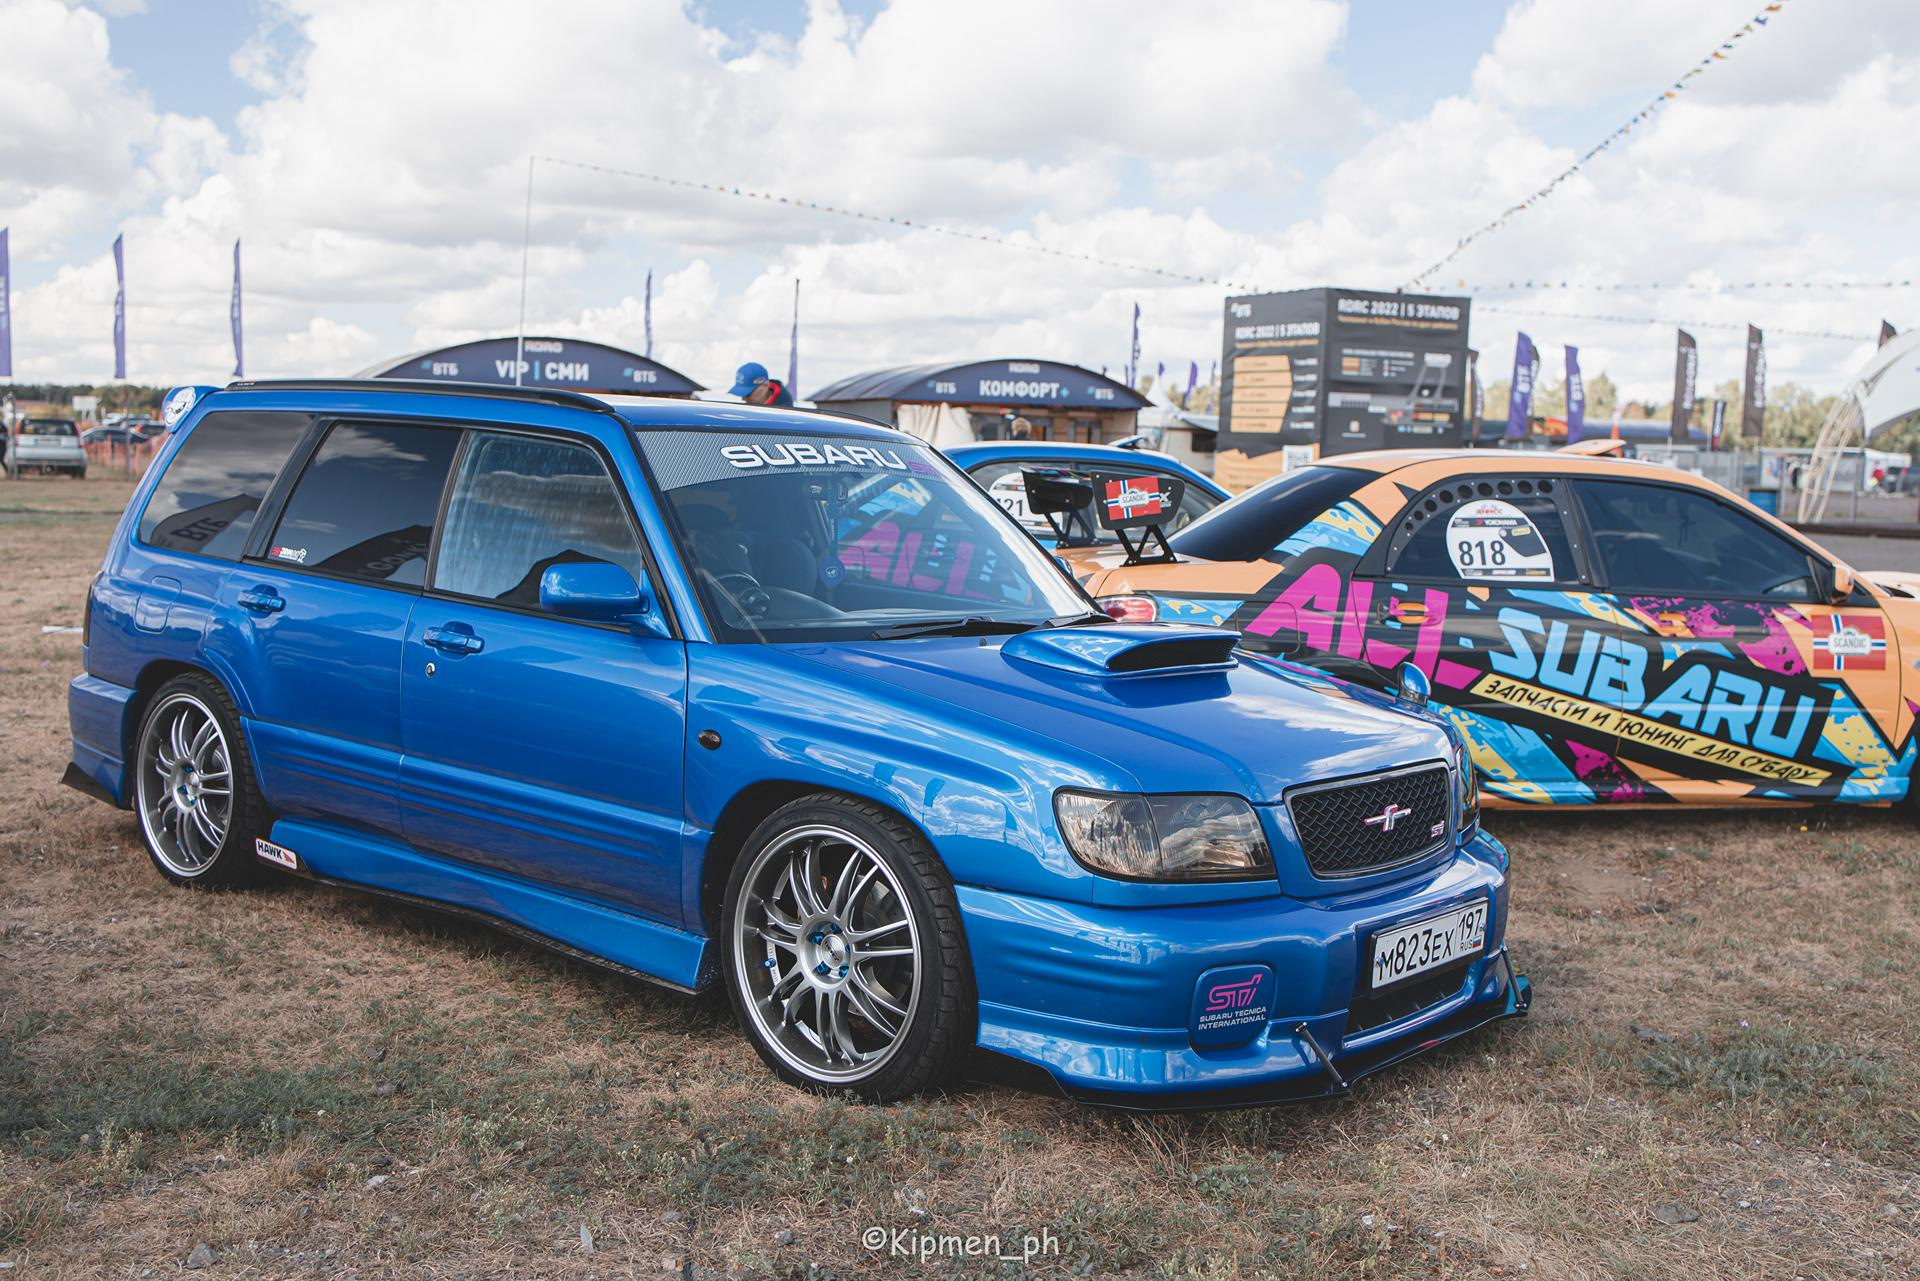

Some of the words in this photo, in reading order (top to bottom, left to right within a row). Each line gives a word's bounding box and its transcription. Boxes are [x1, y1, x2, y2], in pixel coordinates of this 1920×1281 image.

[1370, 300, 1399, 316] 2022
[1416, 304, 1460, 321] ЭТАПОВ
[432, 362, 459, 376] ВТБ
[495, 360, 530, 379] VIP
[544, 362, 590, 382] СМИ
[633, 370, 657, 383] ВТБ
[935, 382, 957, 394] ВТБ
[979, 380, 1060, 399] КОМФОРТ
[1094, 388, 1115, 400] ВТБ
[720, 443, 907, 470] SUBARU
[1121, 494, 1146, 505] SCANDIC
[1458, 540, 1506, 567] 818
[1244, 563, 1482, 690] ALL
[1833, 637, 1867, 649] SCANDIC
[1488, 607, 1815, 758] SUBARU
[1484, 680, 1589, 721] ЗАПЧАСТИ
[1591, 711, 1611, 727] И
[1613, 717, 1696, 750] ТЮНИНГ
[1693, 743, 1740, 763] ДЛЯ
[1740, 755, 1818, 780] СУБАРУ
[257, 840, 283, 860] HAWK
[1458, 908, 1484, 942] 197
[1459, 939, 1473, 953] RUS
[1205, 973, 1264, 1012] STI
[1198, 1014, 1266, 1031] INTERNATIONAL
[1199, 1012, 1233, 1023] SUBARU
[1234, 1005, 1267, 1018] TECNICA
